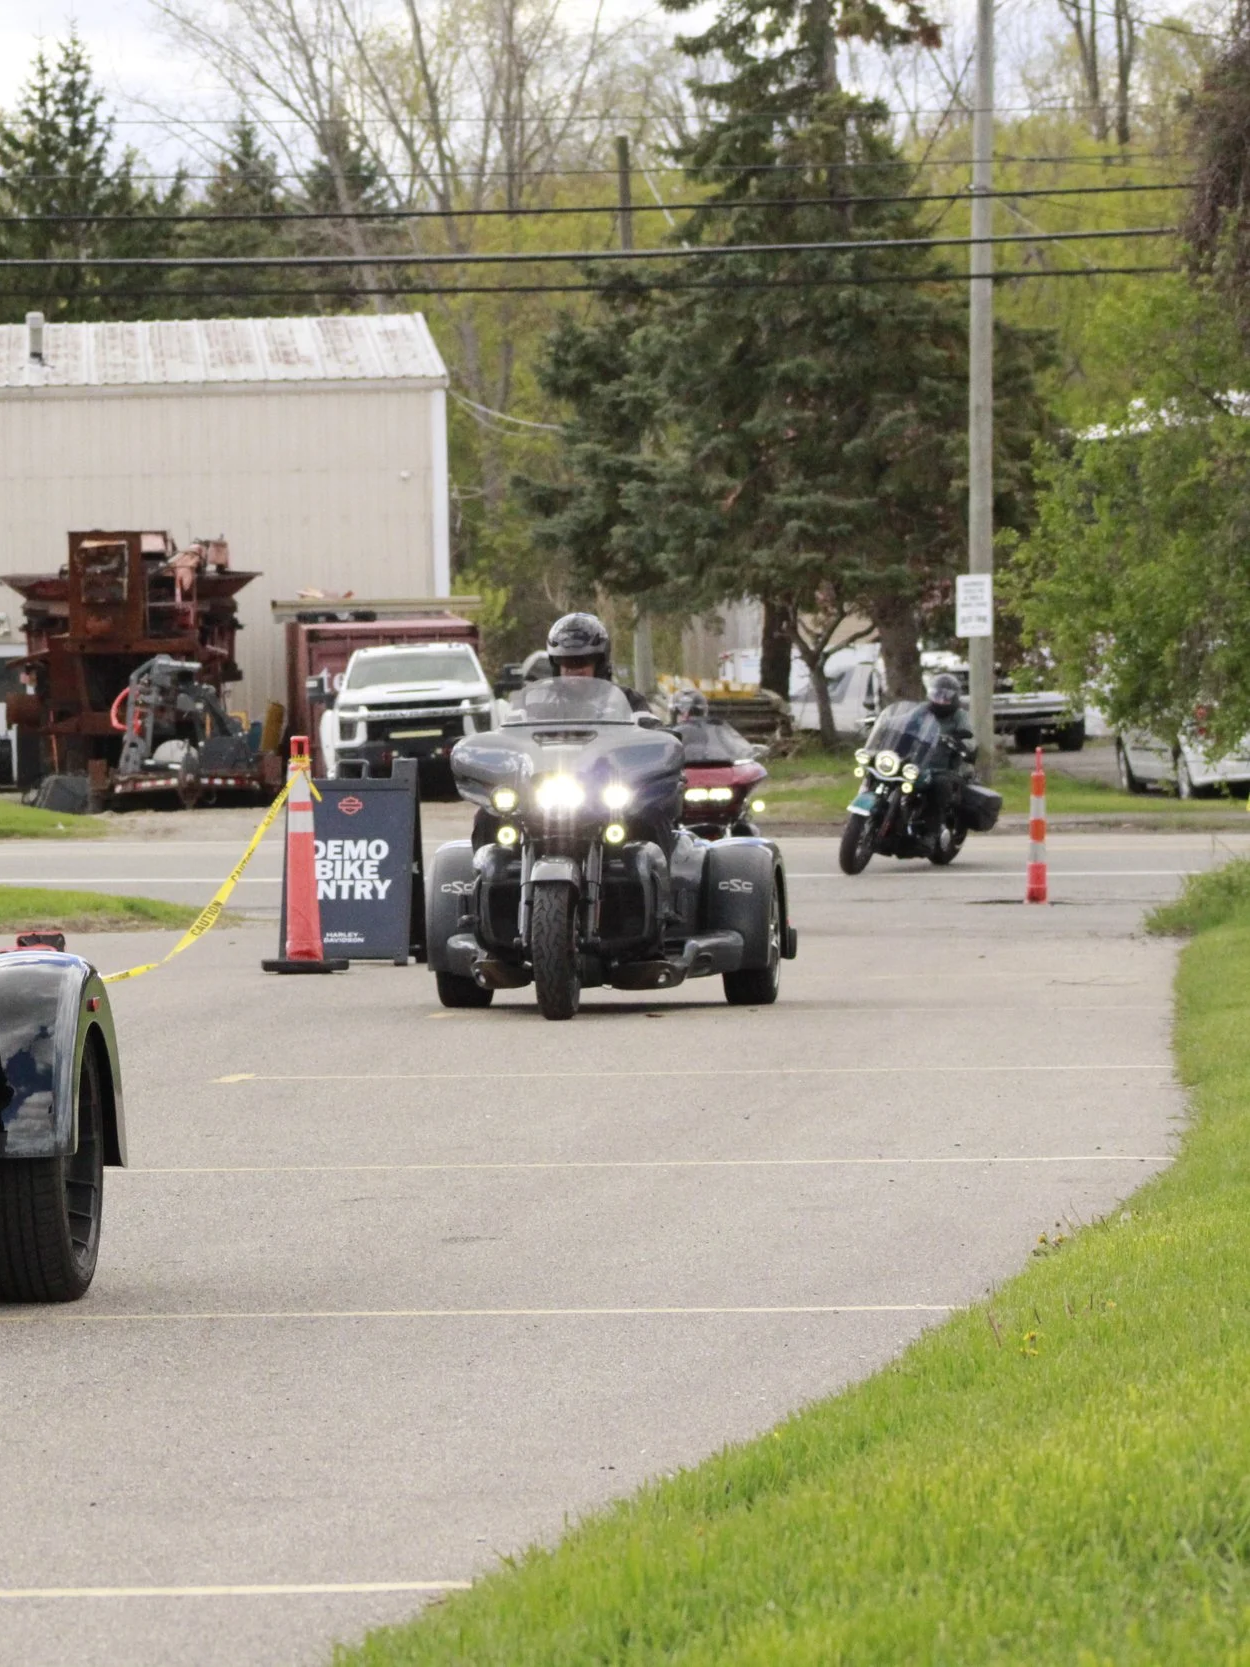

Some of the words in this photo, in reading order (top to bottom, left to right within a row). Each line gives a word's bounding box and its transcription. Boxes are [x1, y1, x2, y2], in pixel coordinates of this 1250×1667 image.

[313, 839, 389, 860] DEMO
[315, 860, 380, 880] BIKE
[317, 880, 392, 900] NTRY
[190, 899, 223, 937] CAUTION
